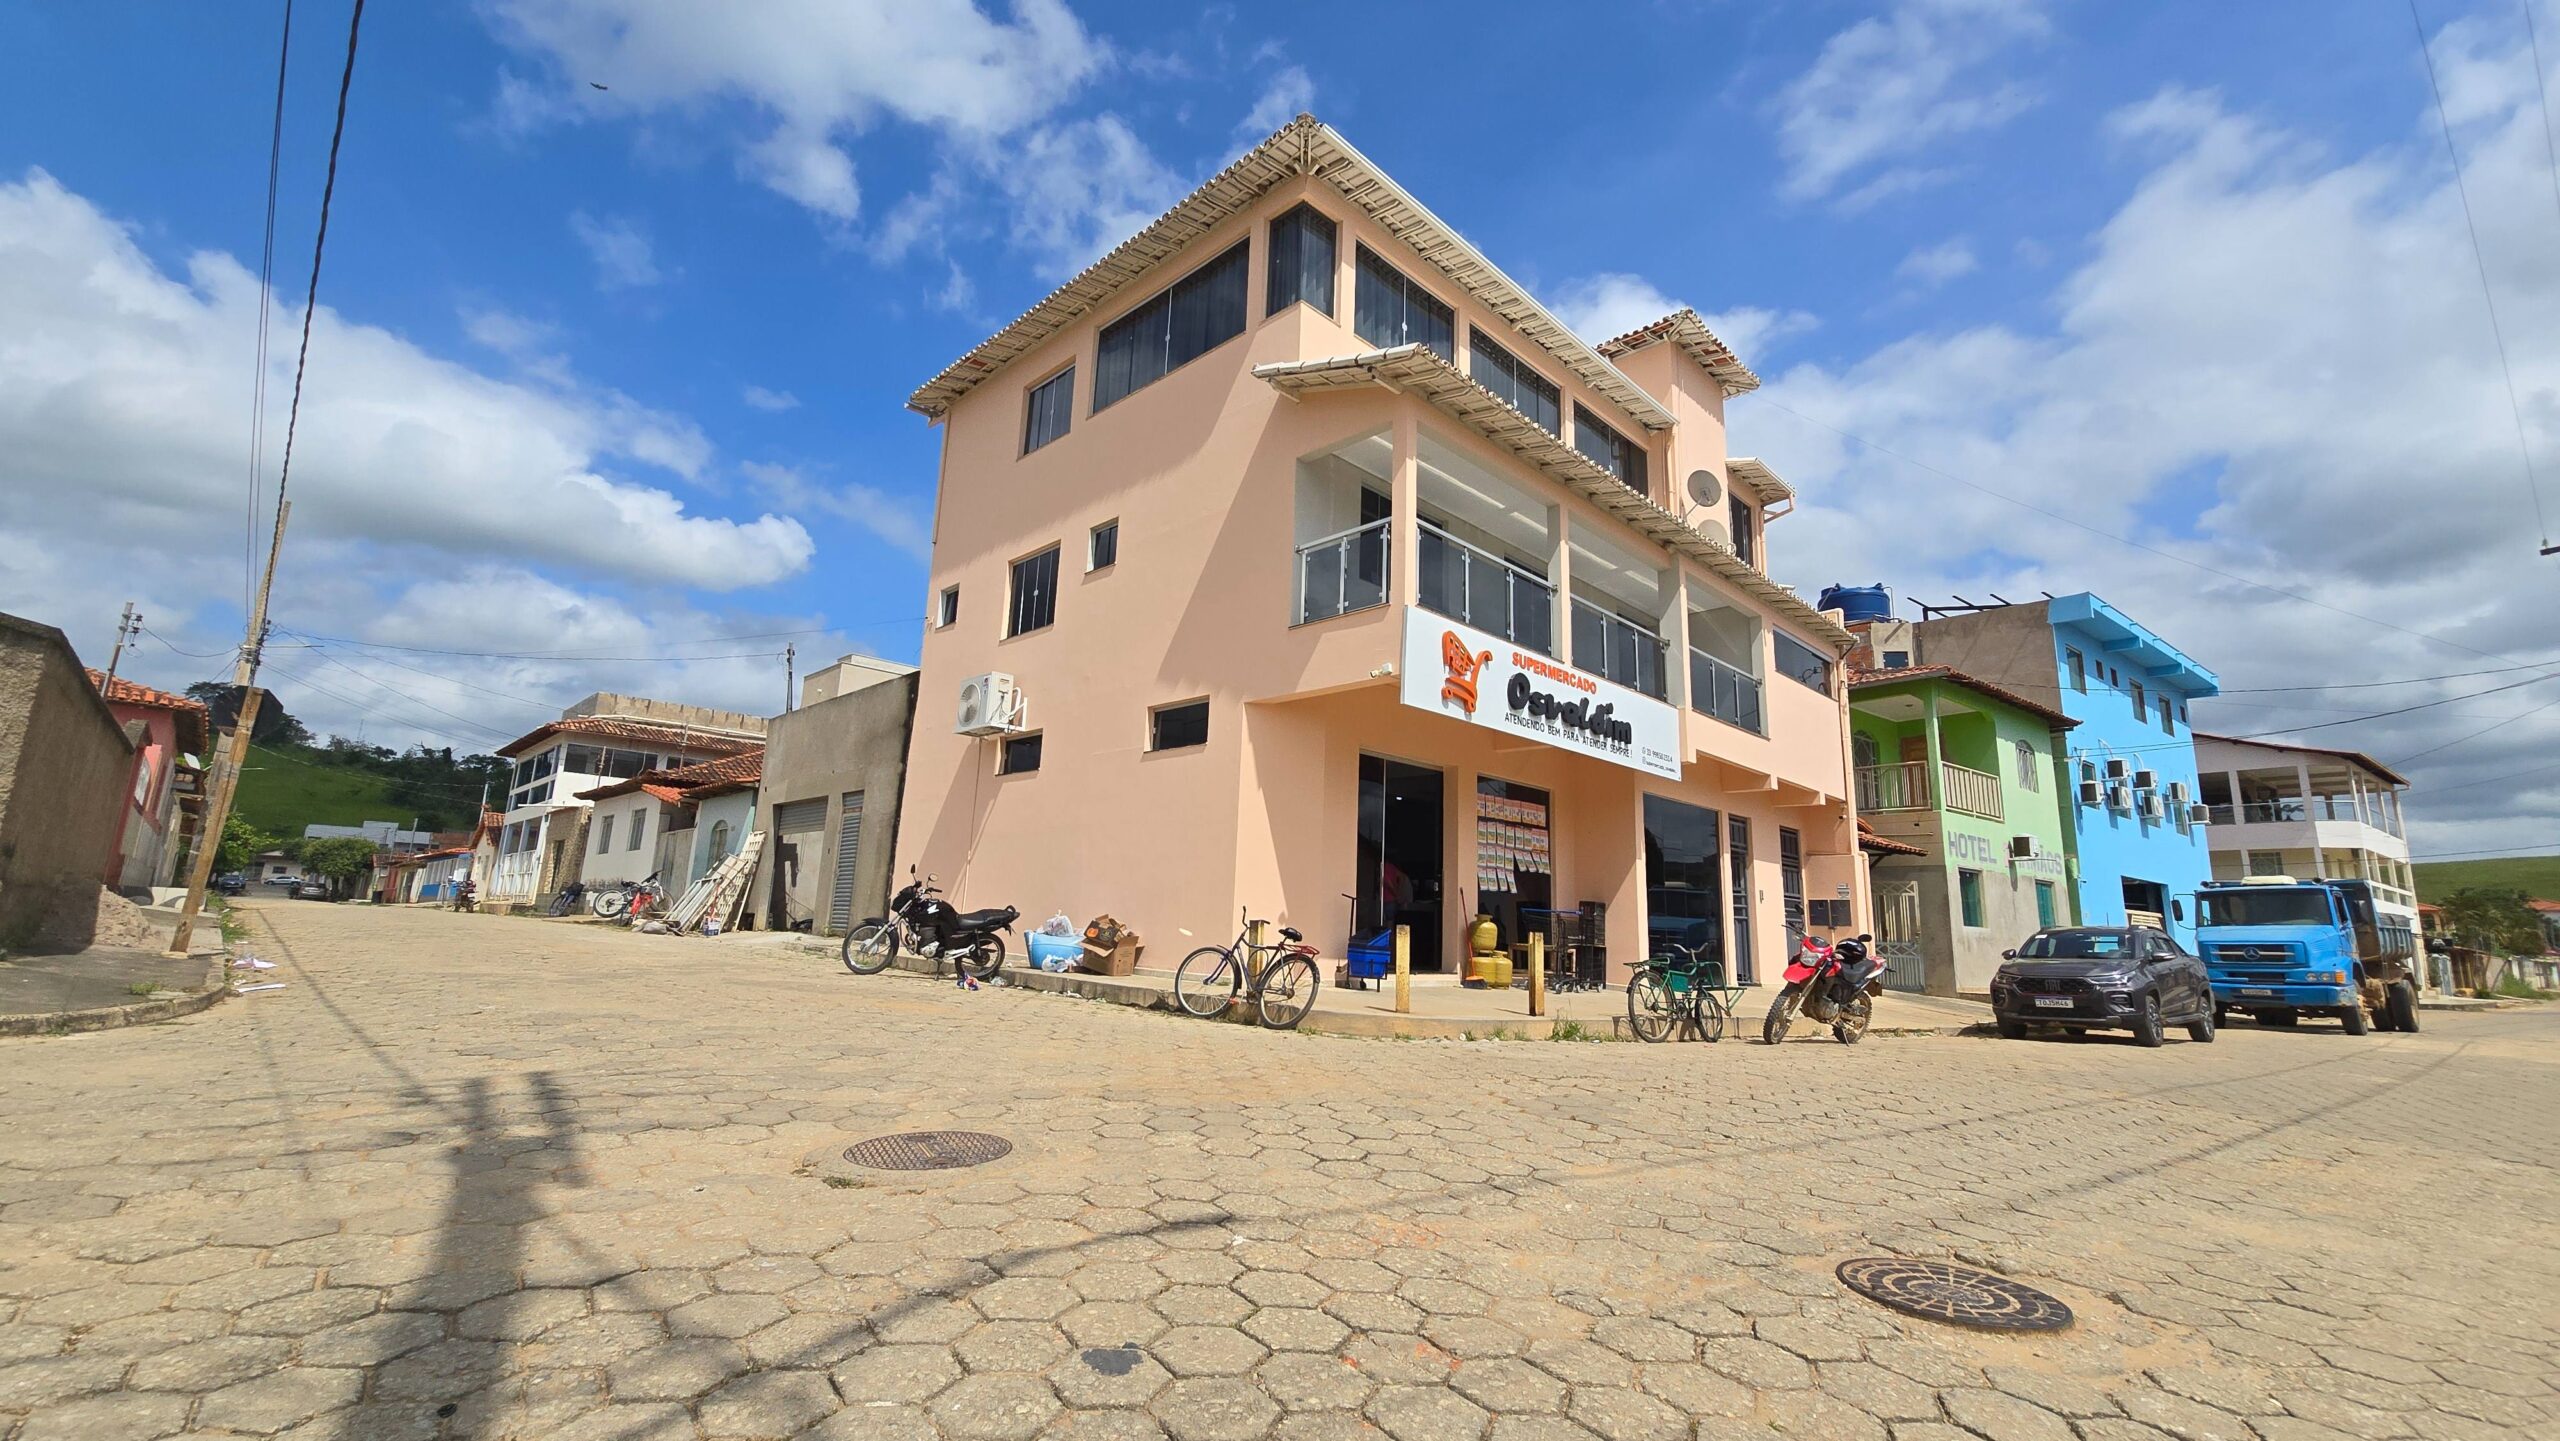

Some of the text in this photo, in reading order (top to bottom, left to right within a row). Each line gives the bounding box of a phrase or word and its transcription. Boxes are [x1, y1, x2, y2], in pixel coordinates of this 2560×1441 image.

[1511, 652, 1597, 695] SUPERMERCADO
[1507, 673, 1632, 745] Osvaldim
[1504, 712, 1545, 733] ATENDENDO
[1547, 725, 1561, 738] BEM
[1563, 729, 1580, 743] PARA
[1582, 736, 1607, 752] ATENDER
[1947, 830, 1997, 864] HOTEL
